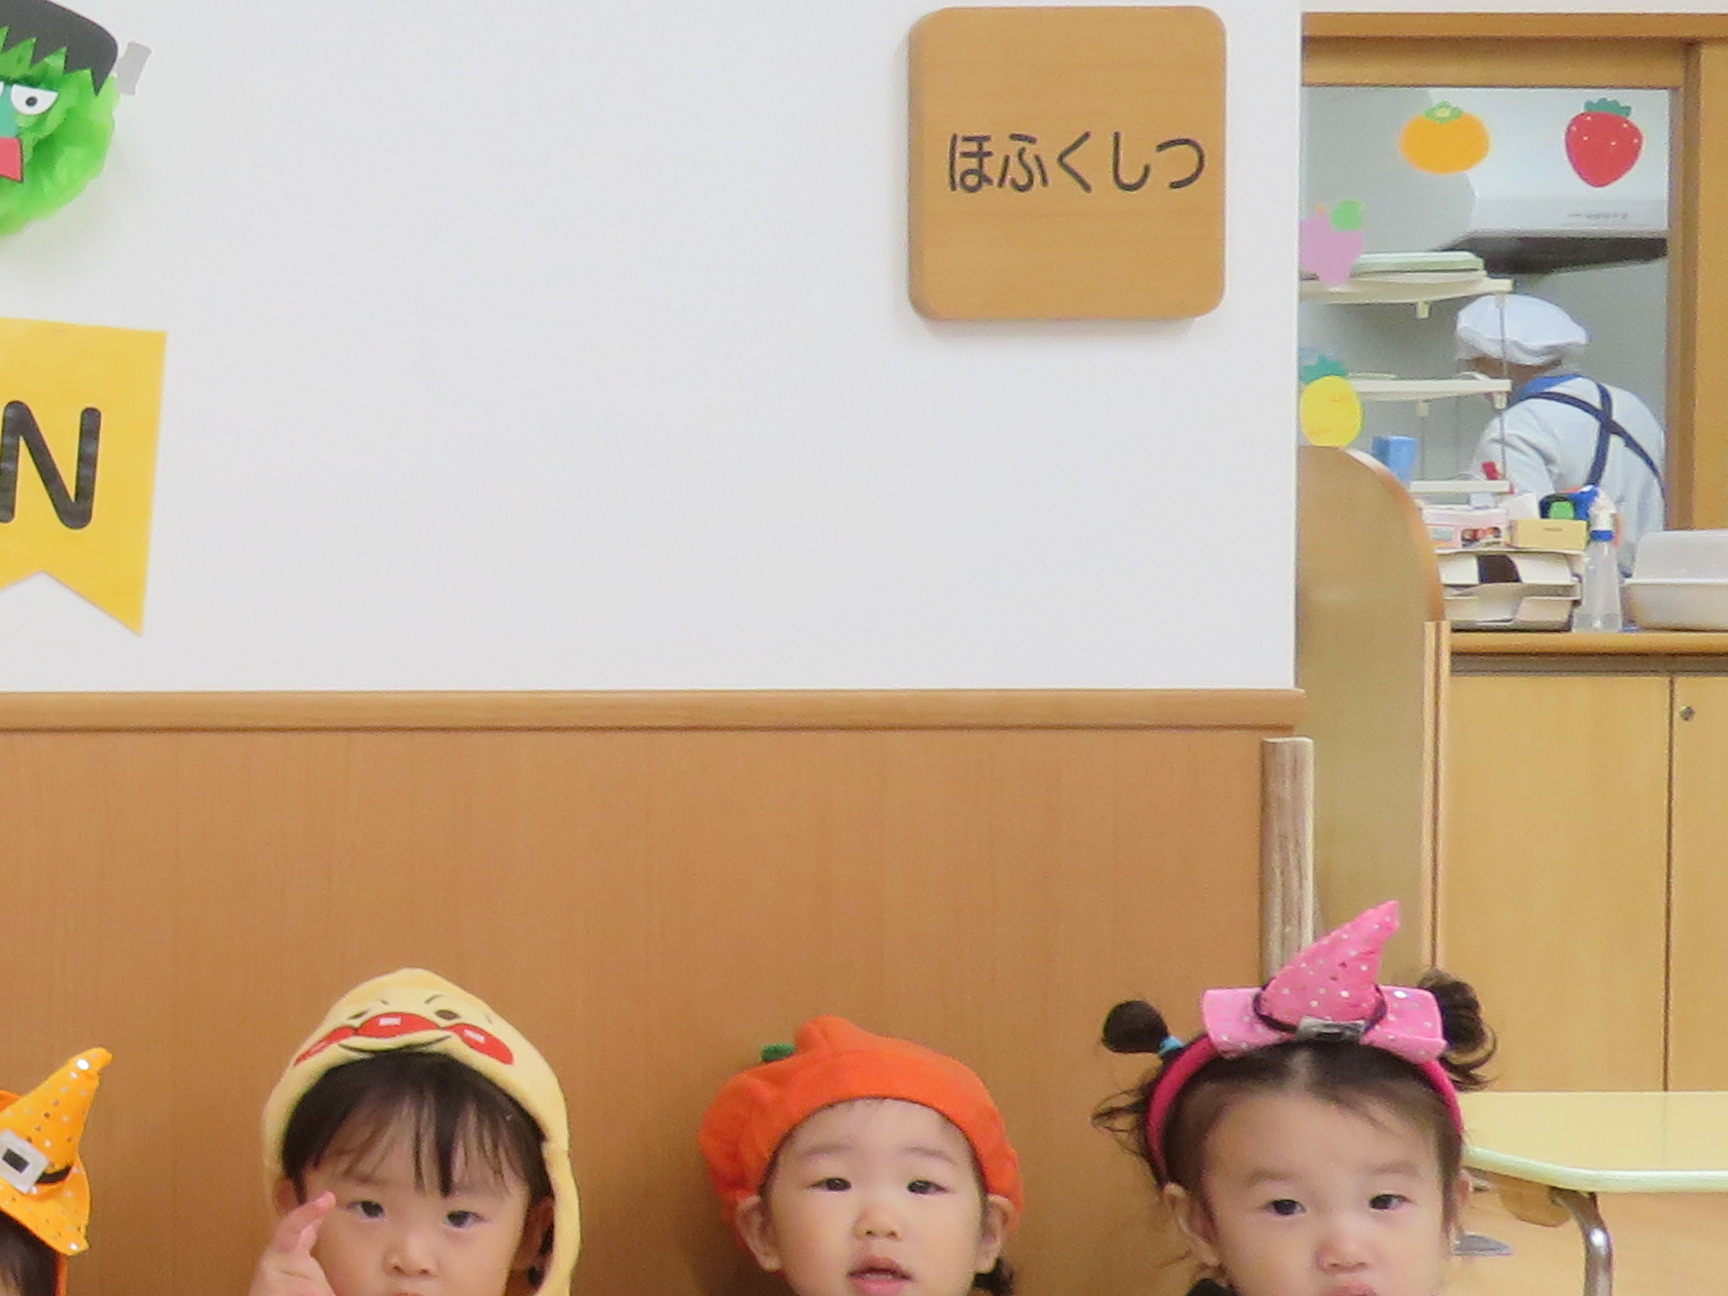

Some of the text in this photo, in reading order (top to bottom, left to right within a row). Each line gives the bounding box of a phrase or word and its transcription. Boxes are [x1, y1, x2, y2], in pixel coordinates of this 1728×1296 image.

[948, 131, 1206, 194] ほふくしつ
